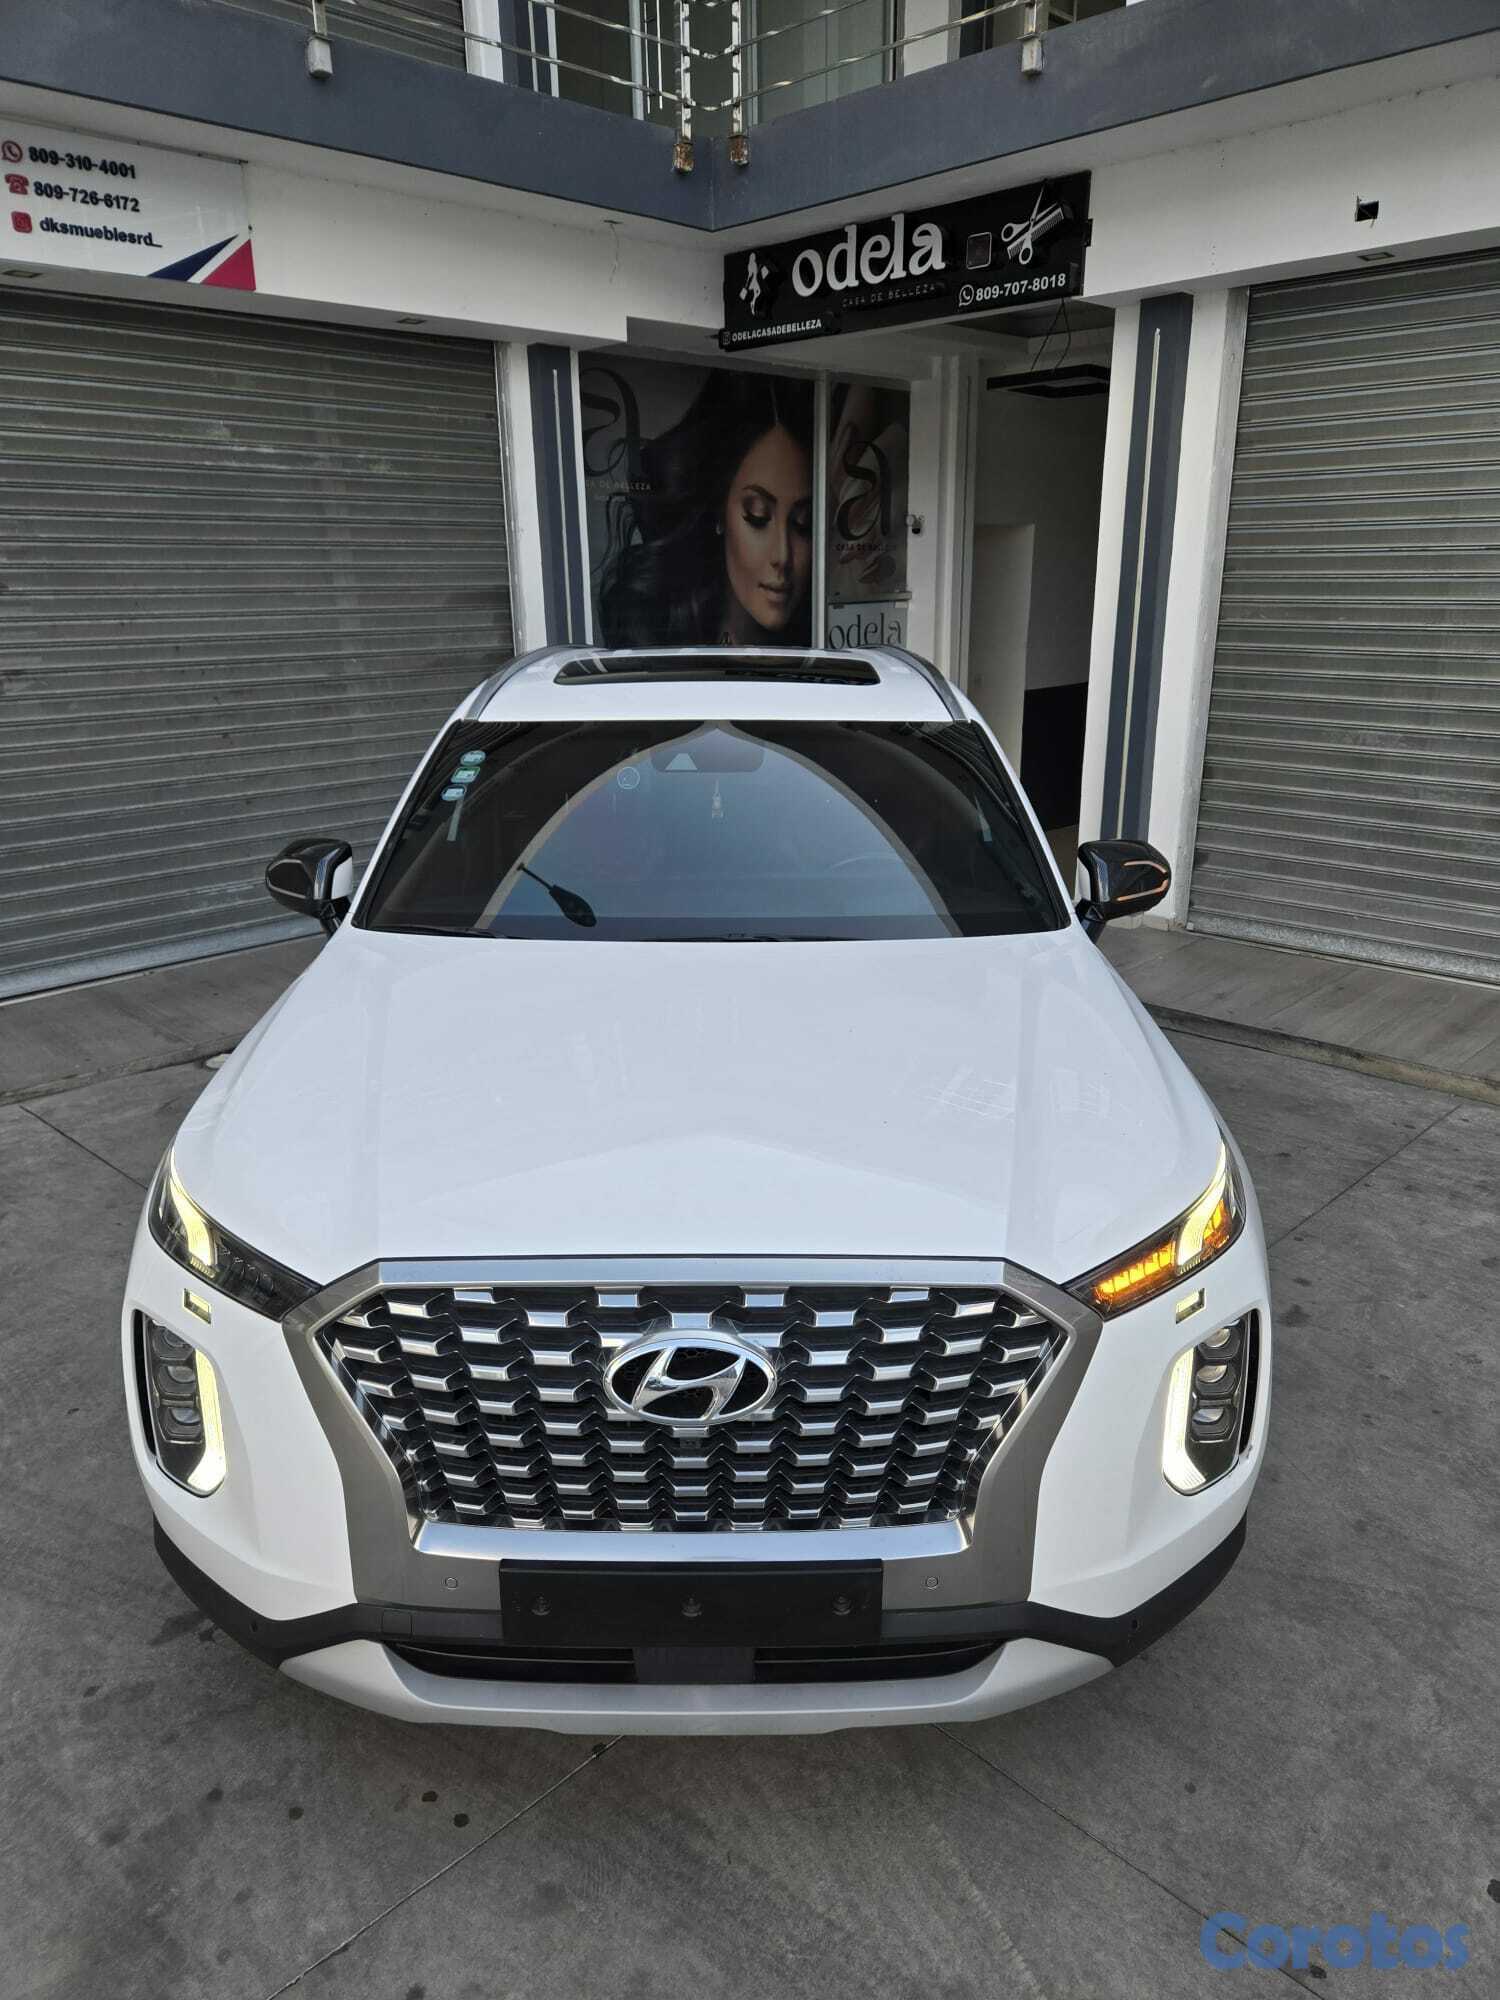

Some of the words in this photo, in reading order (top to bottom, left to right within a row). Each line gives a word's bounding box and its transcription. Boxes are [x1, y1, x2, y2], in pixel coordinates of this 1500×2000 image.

[28, 146, 136, 179] 809-310-4001
[34, 181, 141, 213] 809-726-6172
[792, 213, 946, 297] odela
[975, 273, 1066, 302] 809-707-8018
[731, 318, 822, 342] ODELACASADEBELLEZA
[828, 612, 903, 650] odela
